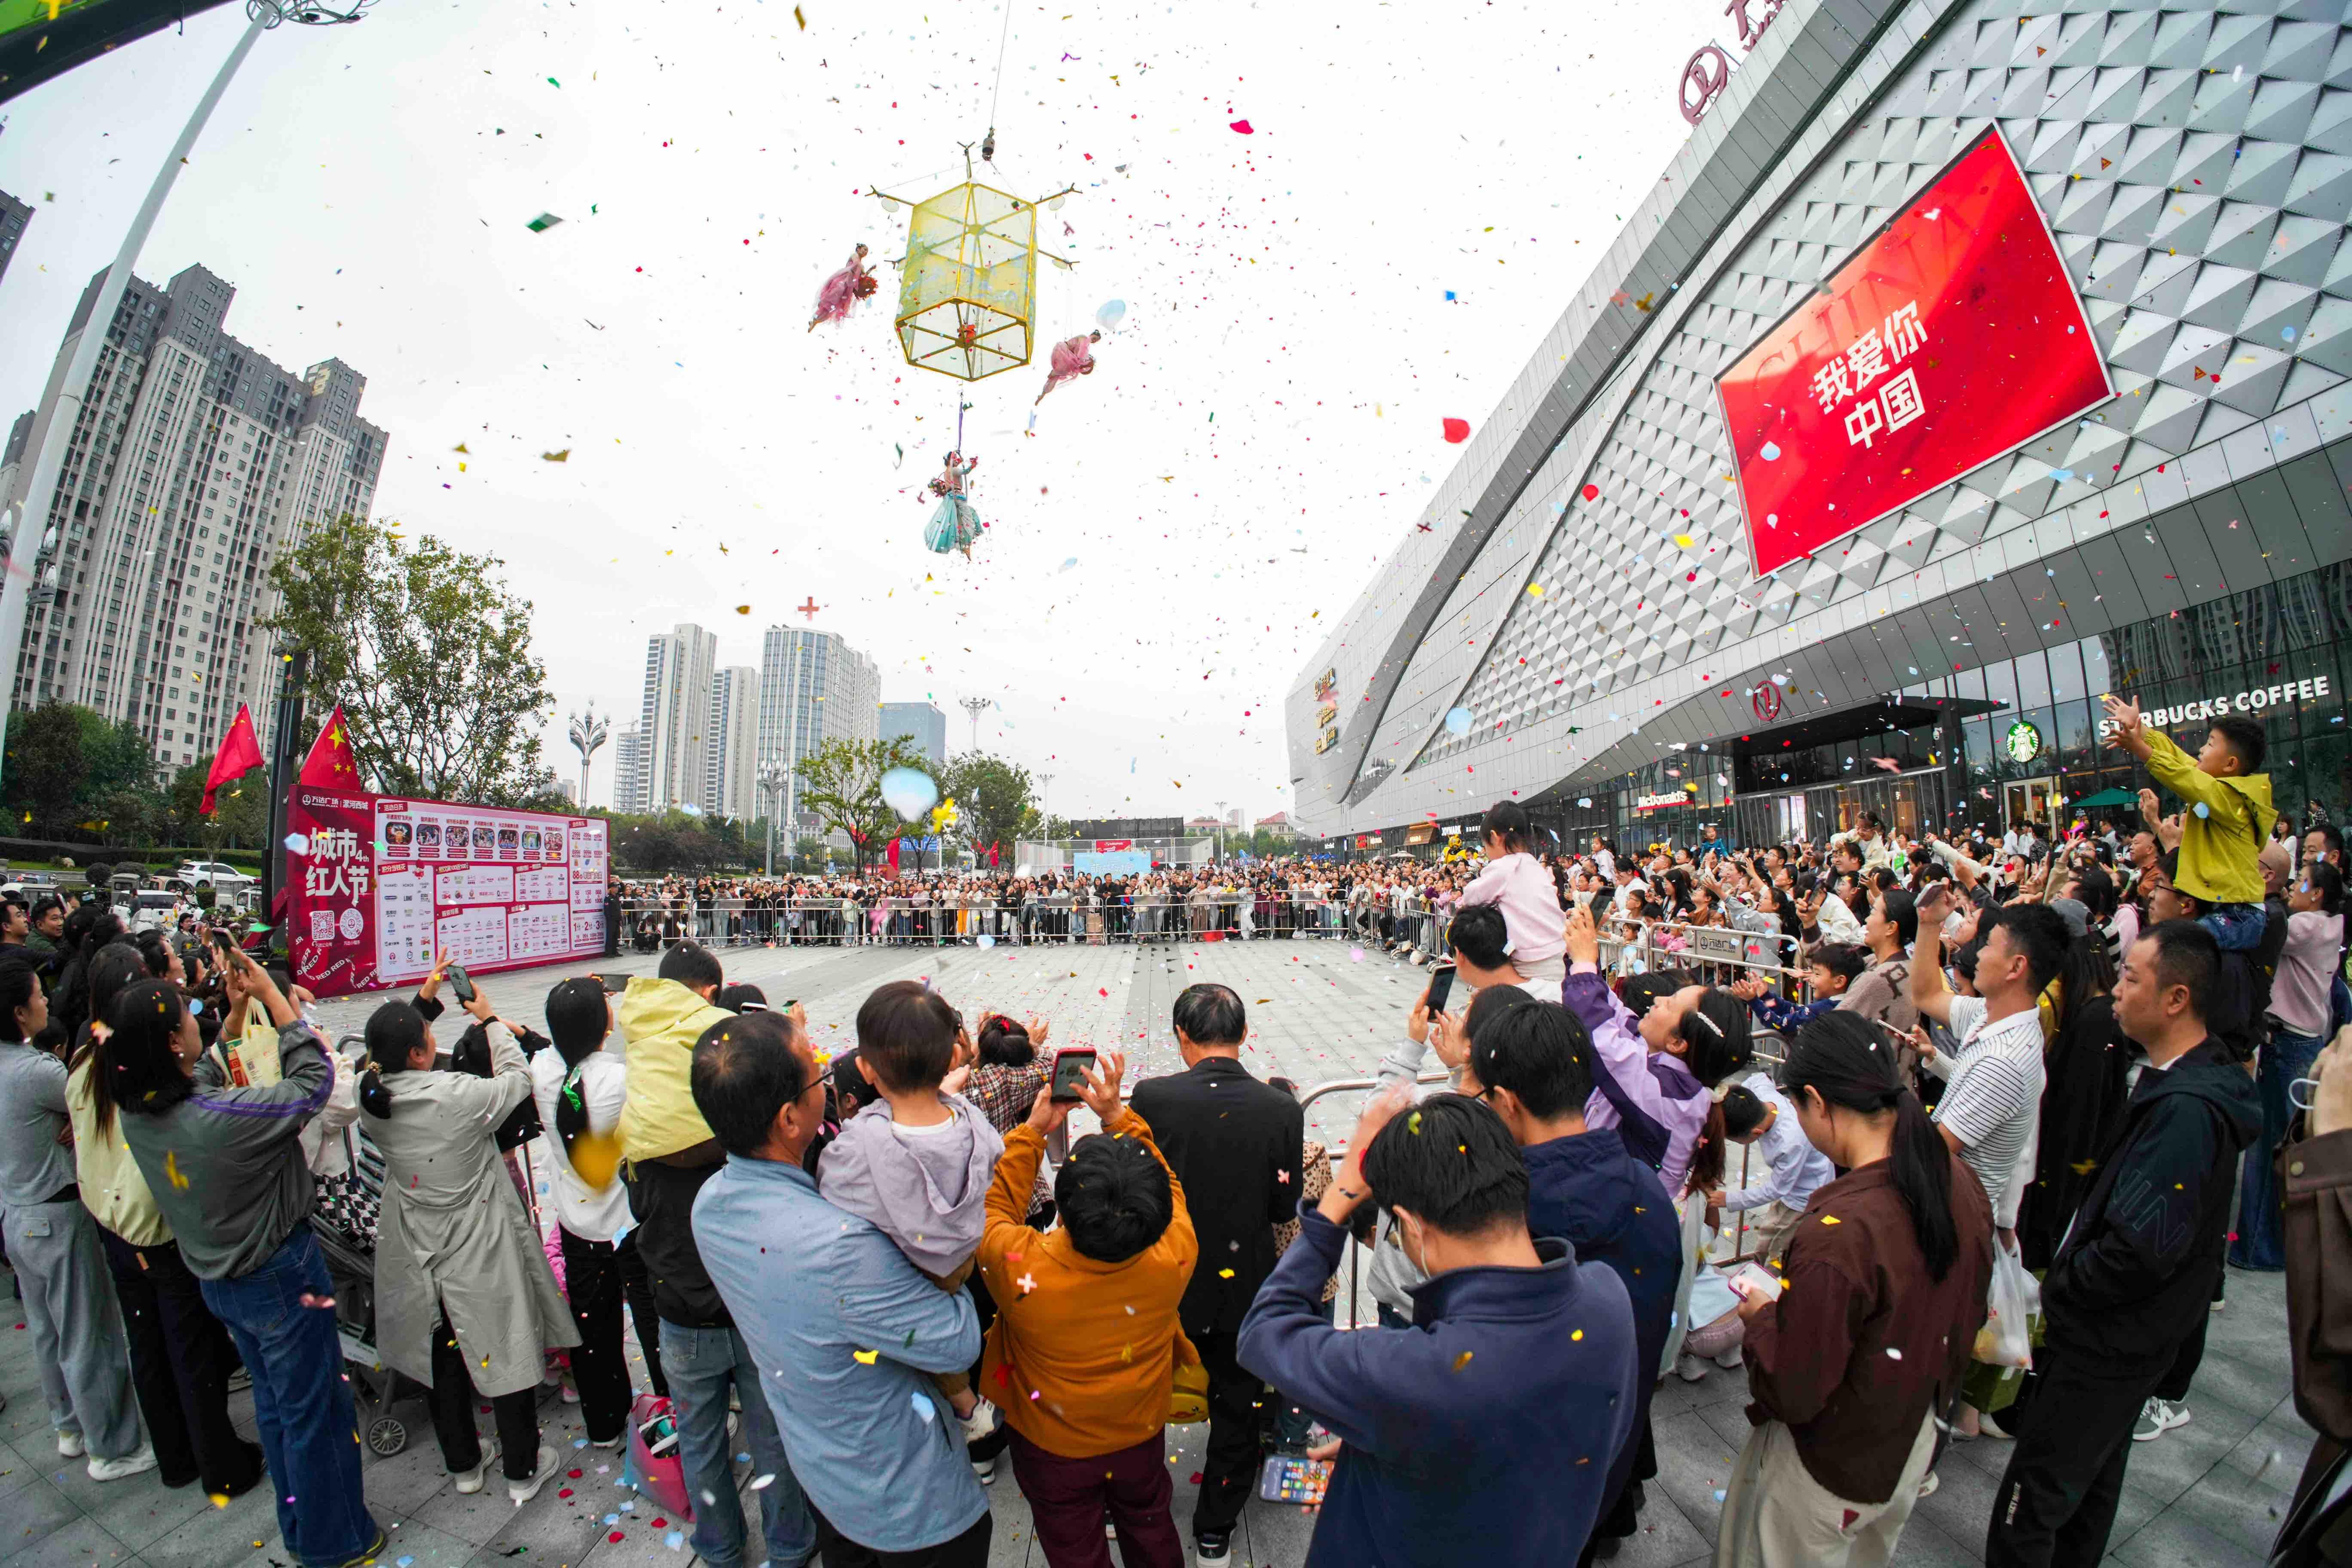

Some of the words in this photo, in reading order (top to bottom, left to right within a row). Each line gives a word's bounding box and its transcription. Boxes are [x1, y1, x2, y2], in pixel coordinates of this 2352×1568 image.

[1813, 300, 1928, 415] 我爱你
[1844, 367, 1925, 449] 中国
[2098, 696, 2229, 737] STRBUCKS
[2235, 675, 2330, 711] COFFEE
[312, 795, 339, 805] 万达广场
[1638, 790, 1688, 808] McDonald's
[309, 827, 358, 870] 城市
[355, 850, 369, 862] 4th
[305, 865, 370, 907] 红人节
[316, 970, 331, 980] RED
[330, 960, 345, 972] RED
[357, 976, 370, 989] RED
